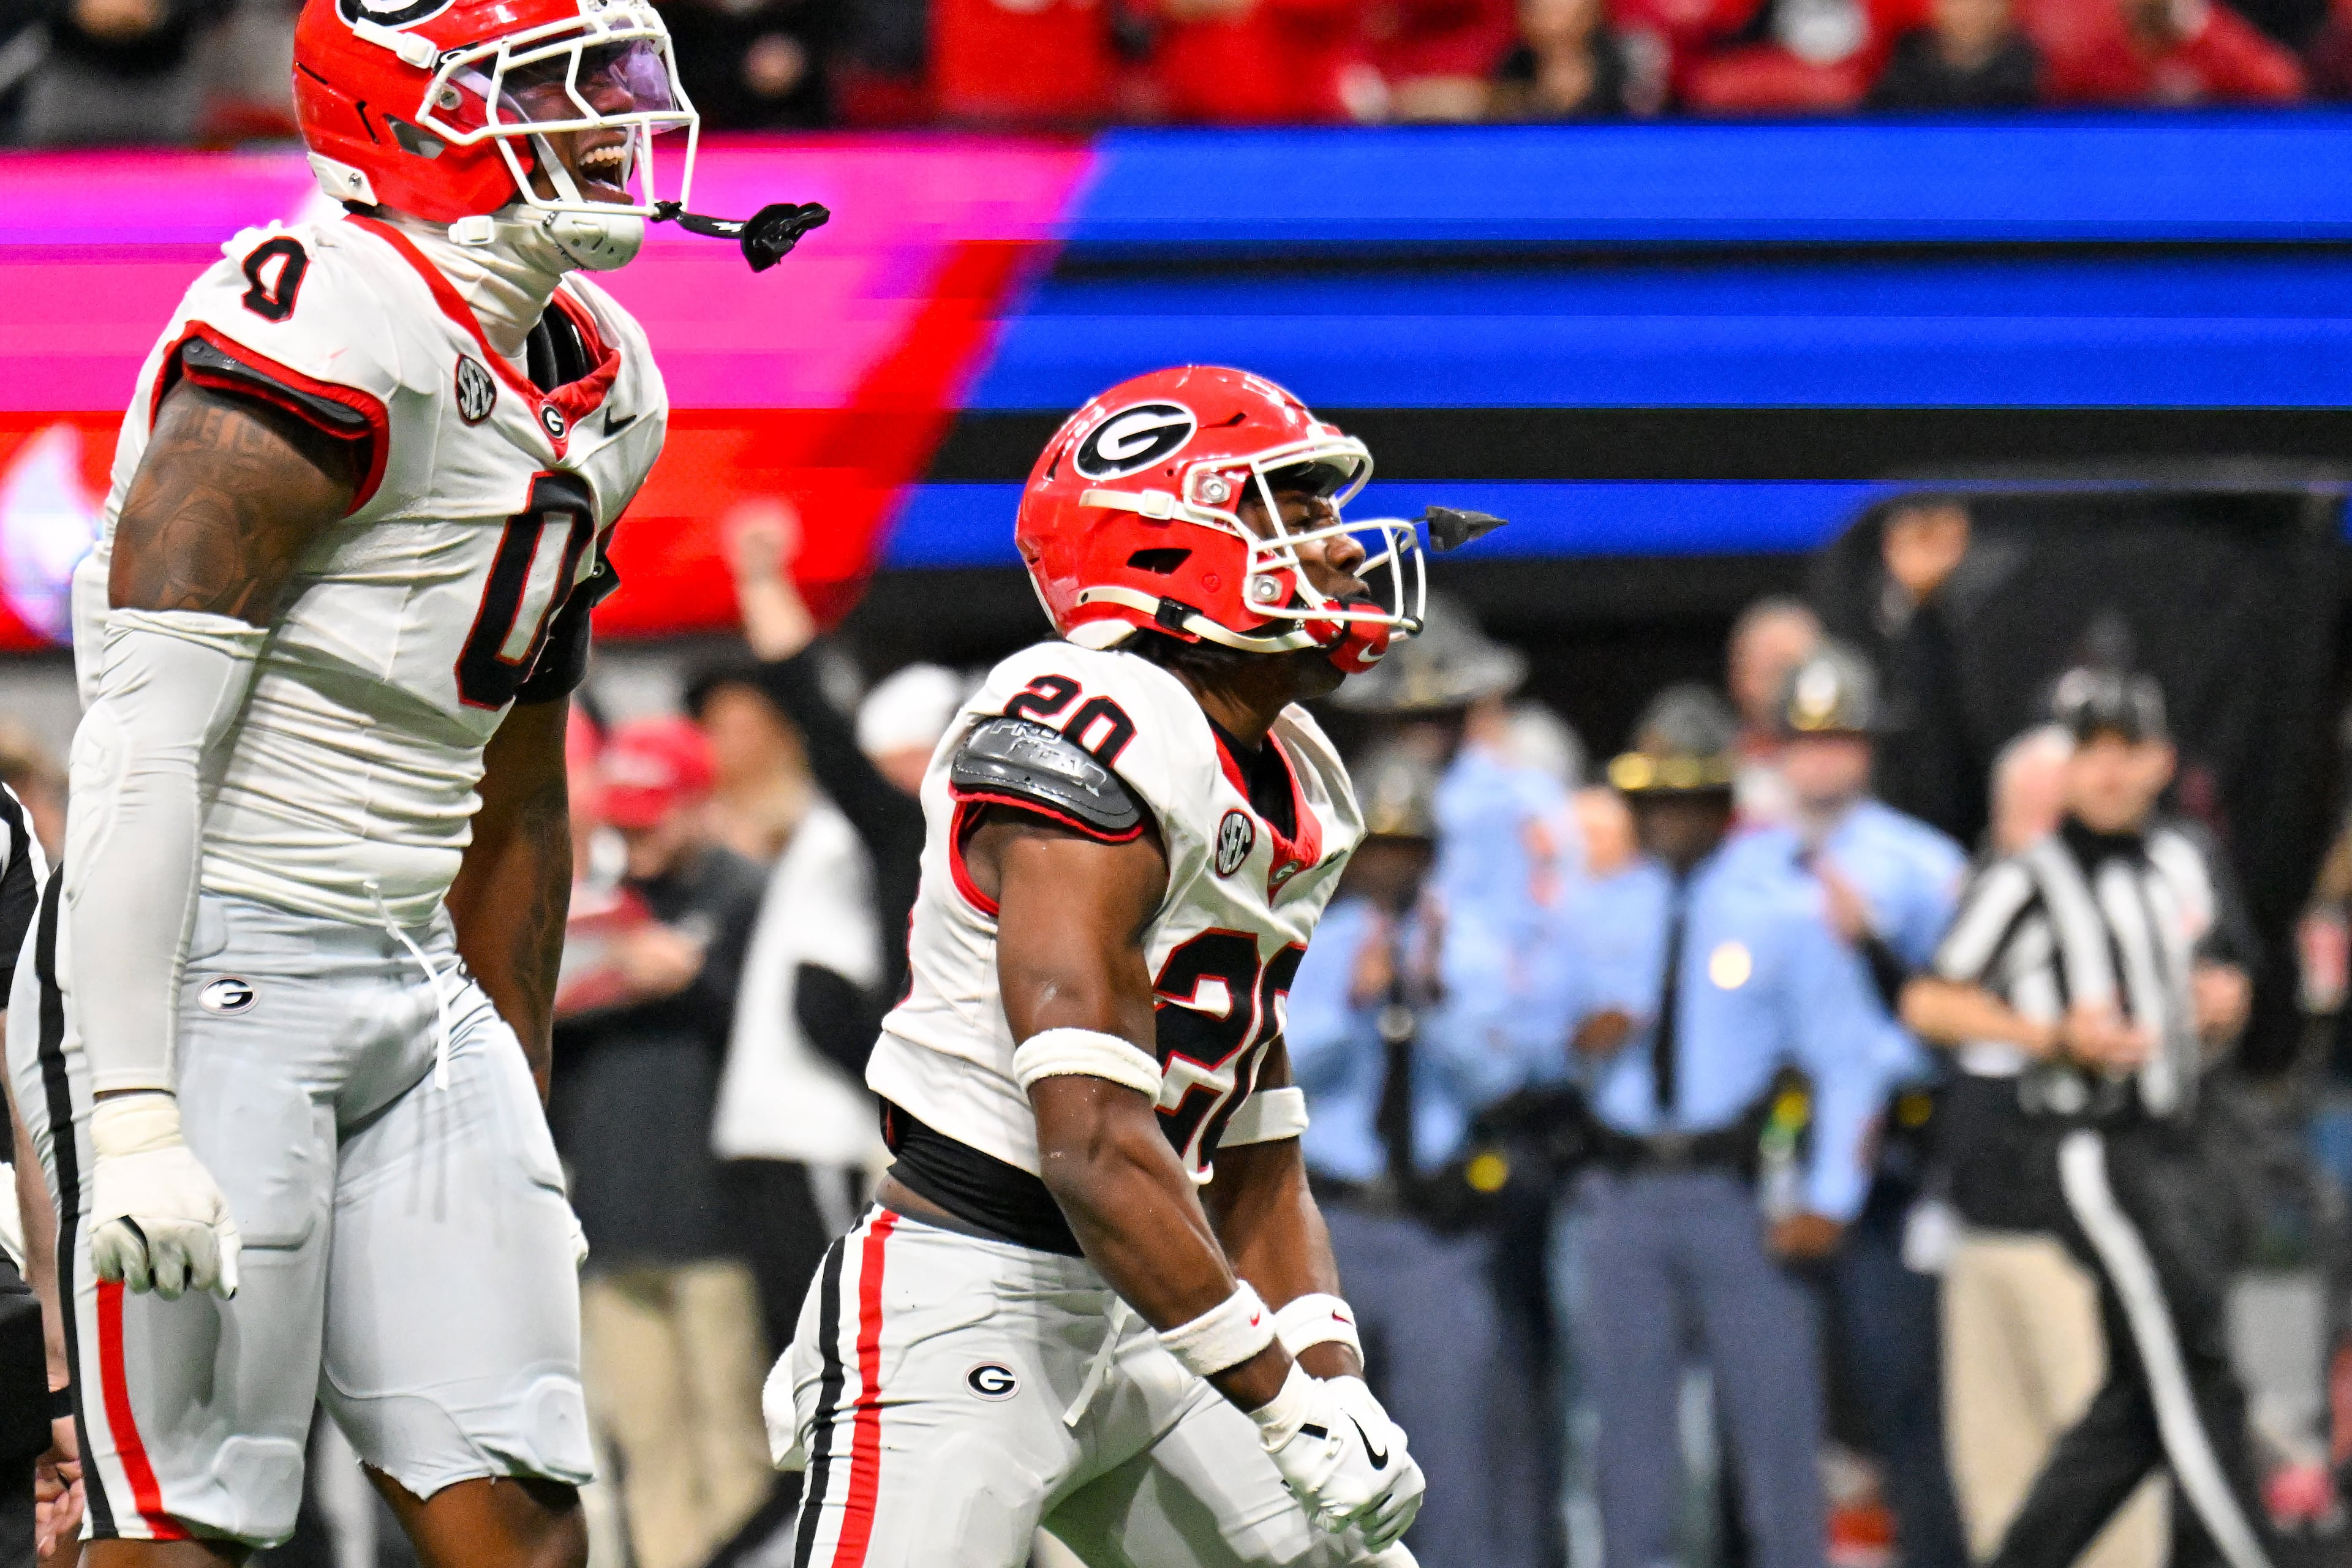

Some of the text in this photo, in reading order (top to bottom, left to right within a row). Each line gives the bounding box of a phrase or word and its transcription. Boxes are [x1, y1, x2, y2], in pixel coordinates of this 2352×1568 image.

[241, 235, 311, 324] 0
[457, 356, 495, 421] SEC
[543, 407, 564, 435] G
[1080, 405, 1193, 473] G
[454, 470, 596, 712] 0
[1003, 674, 1138, 769] 20
[1218, 813, 1253, 875] SEC
[206, 979, 254, 1009] G
[969, 1365, 1017, 1395] G
